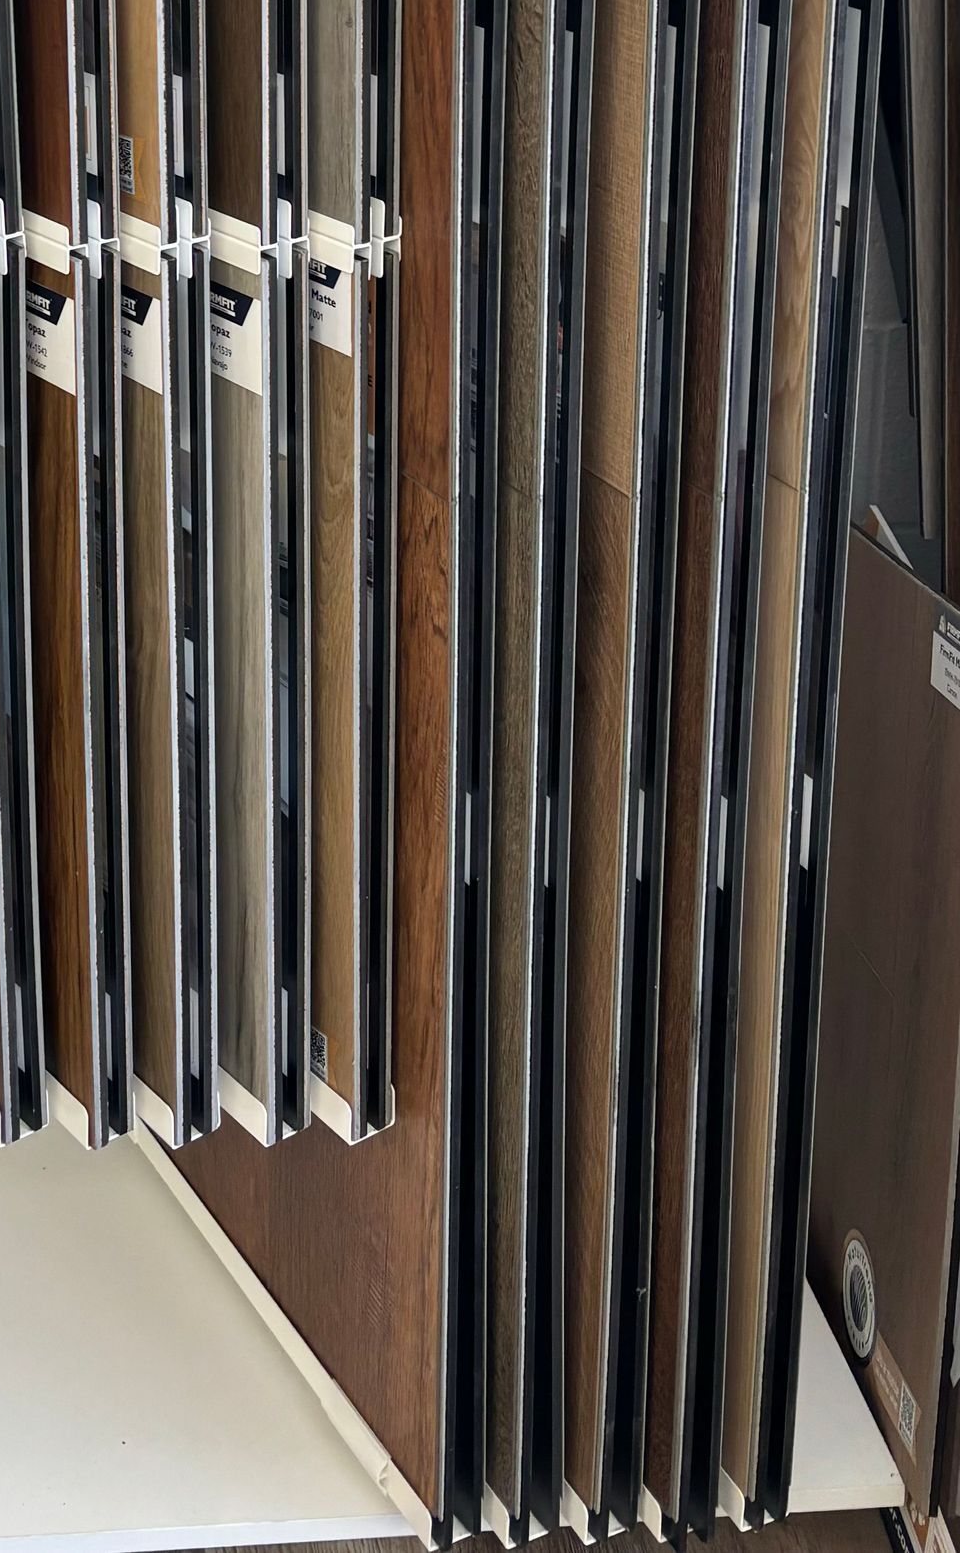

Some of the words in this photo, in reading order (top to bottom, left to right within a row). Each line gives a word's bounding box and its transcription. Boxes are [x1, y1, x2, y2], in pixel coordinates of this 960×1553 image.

[26, 289, 52, 311] RMFIT
[210, 292, 236, 312] RMFIT
[311, 288, 336, 308] Matte
[26, 319, 46, 338] opaz
[211, 323, 230, 339] opaz
